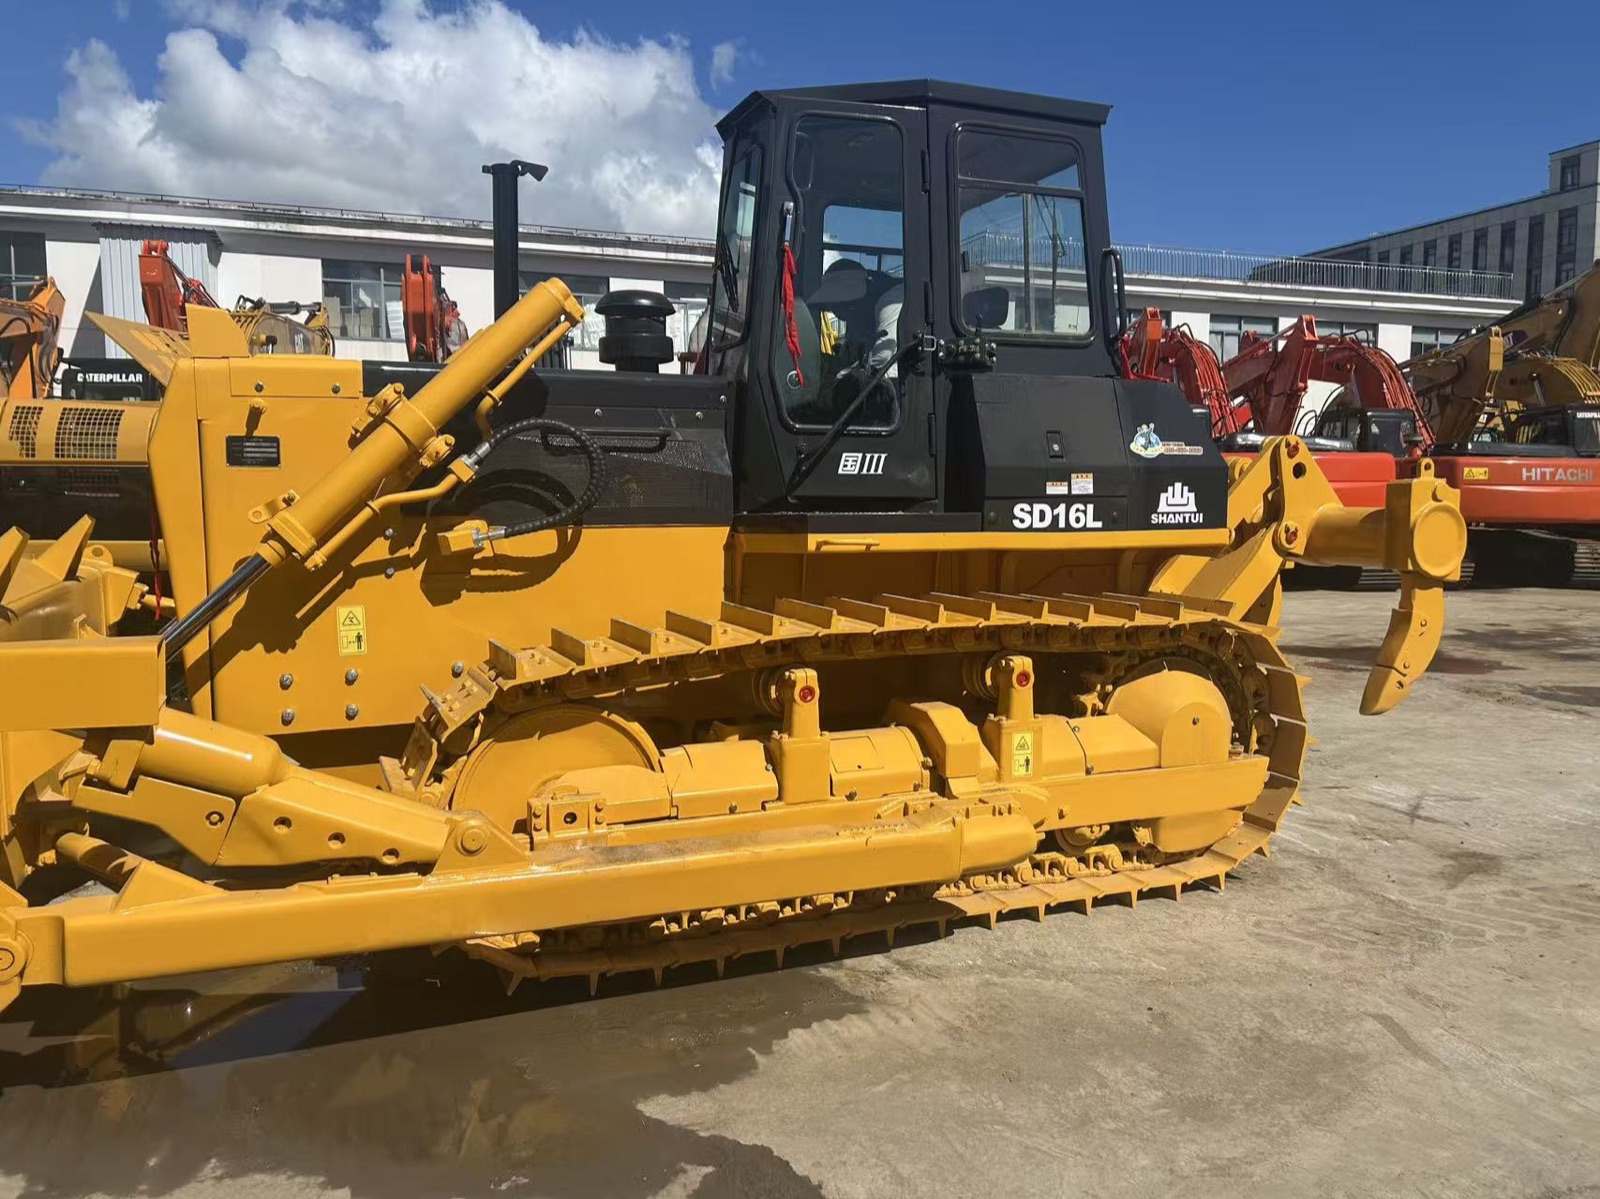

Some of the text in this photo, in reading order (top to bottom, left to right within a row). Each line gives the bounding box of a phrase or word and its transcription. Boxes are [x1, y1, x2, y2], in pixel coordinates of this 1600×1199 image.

[1522, 467, 1593, 481] HITACHI
[1012, 502, 1103, 529] SD16L
[1150, 512, 1204, 524] SHANTUI
